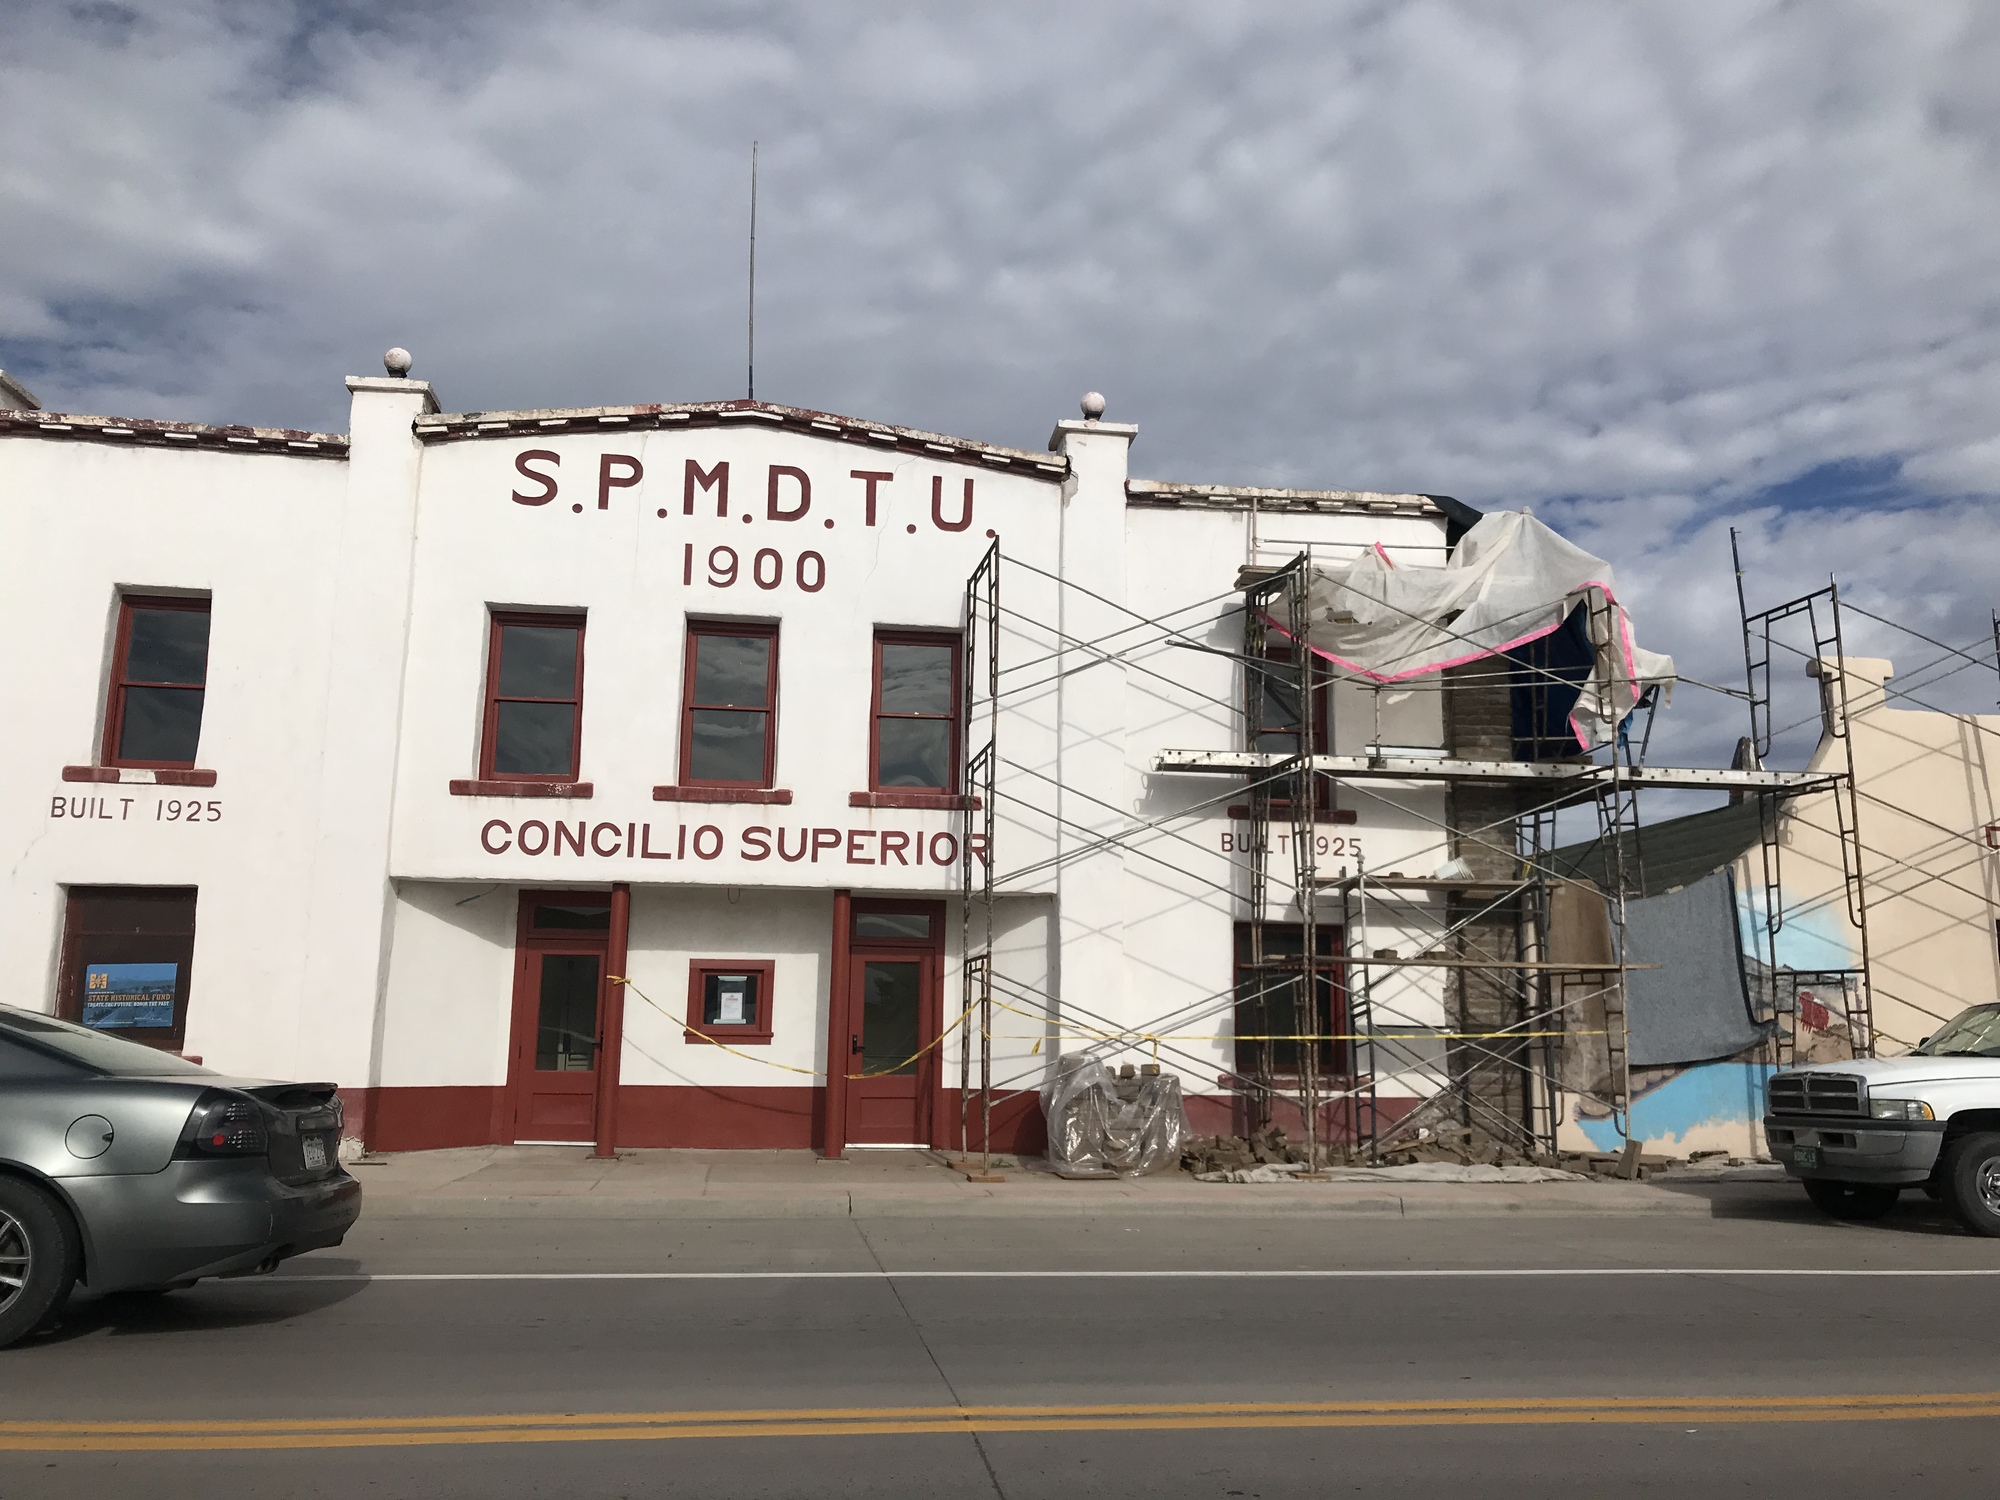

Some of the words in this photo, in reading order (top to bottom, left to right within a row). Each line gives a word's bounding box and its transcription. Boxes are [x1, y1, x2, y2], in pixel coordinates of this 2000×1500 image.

[683, 543, 826, 592] 1900
[50, 796, 135, 821] BUILT
[156, 799, 222, 822] 1925
[480, 819, 723, 860] CONCILIO
[740, 825, 990, 868] SUPERIOR
[1221, 832, 1290, 855] BULT
[1308, 835, 1362, 856] 925
[88, 994, 110, 1002] STATE
